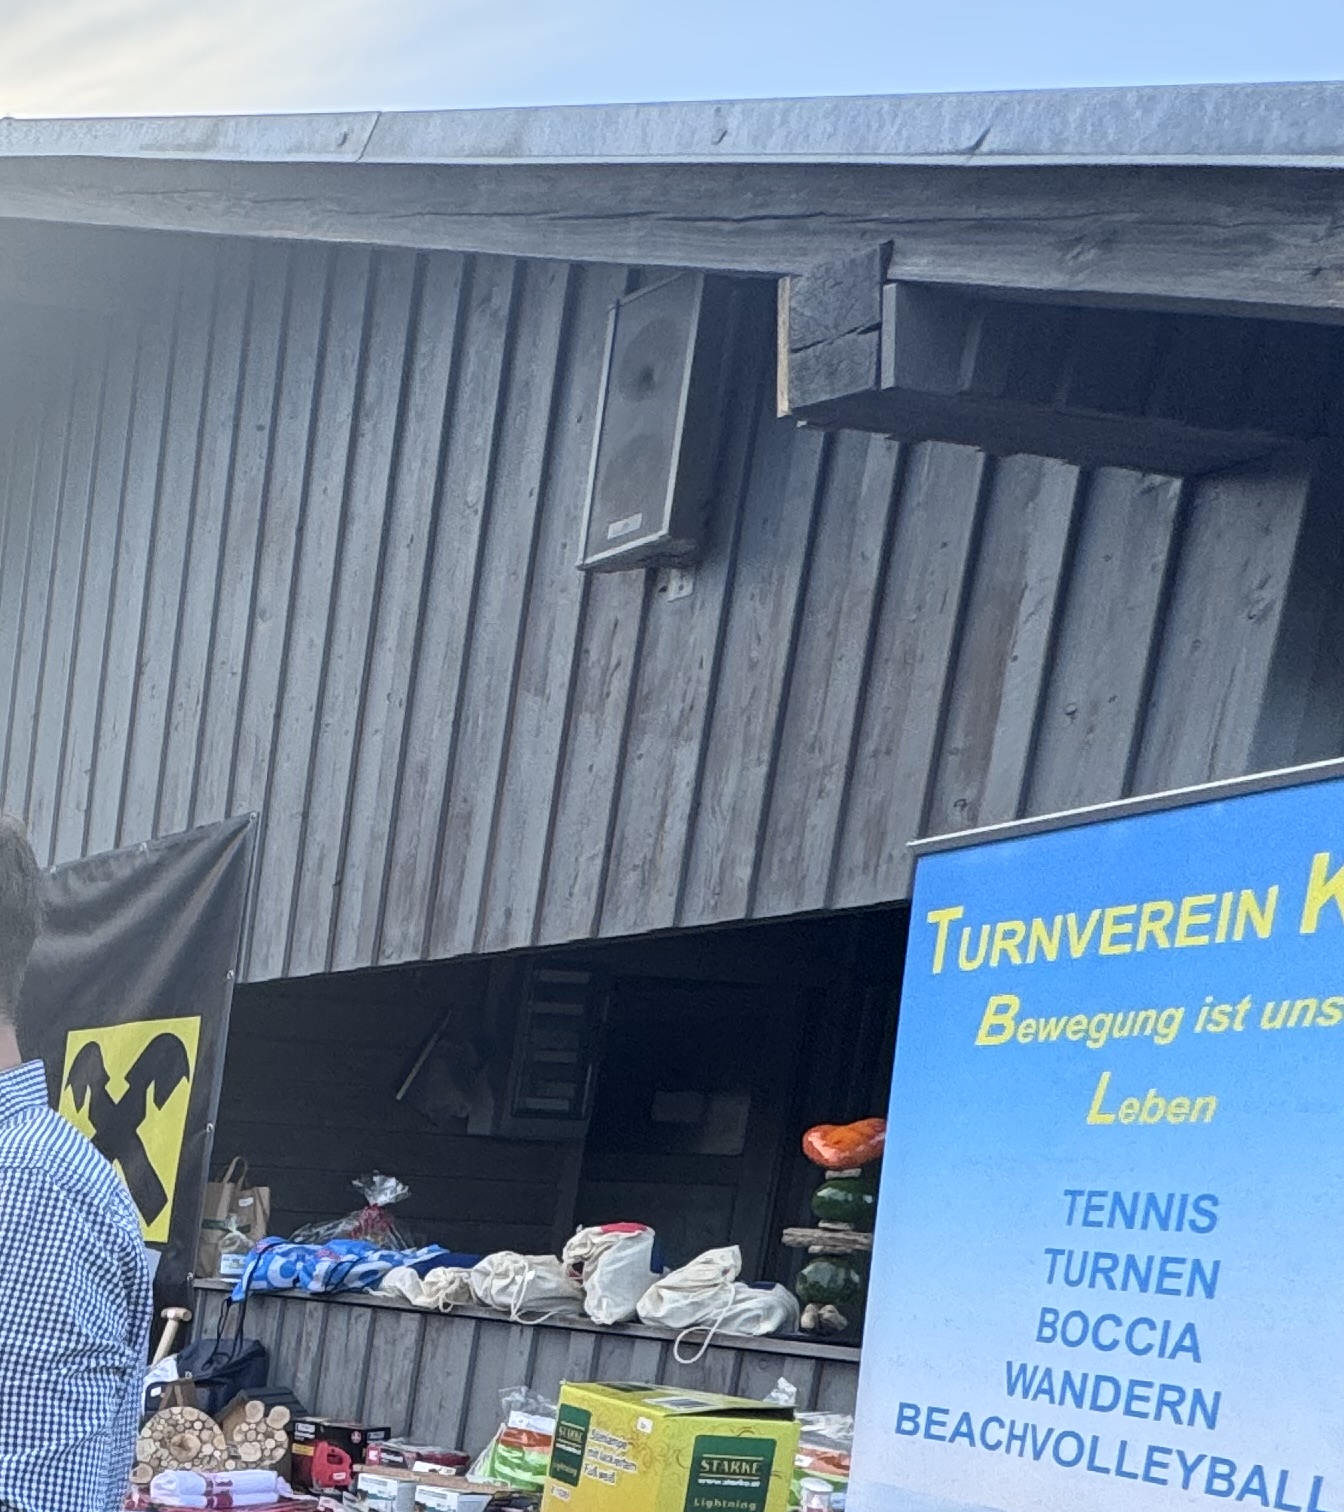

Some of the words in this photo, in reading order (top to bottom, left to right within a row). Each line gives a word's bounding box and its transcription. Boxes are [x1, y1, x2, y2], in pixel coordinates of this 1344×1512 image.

[926, 884, 1280, 976] TURNVEREIN
[974, 993, 1185, 1050] Bewegung
[1193, 994, 1252, 1034] ist
[1259, 995, 1344, 1031] uns
[1086, 1070, 1218, 1126] Leben
[1064, 1188, 1220, 1235] TENNIS
[1044, 1247, 1221, 1300] TURNEN
[1035, 1306, 1202, 1364] BOCCIA
[1005, 1360, 1222, 1431] WANDERN
[700, 1458, 762, 1475] STARKE
[693, 1497, 757, 1512] Lightning
